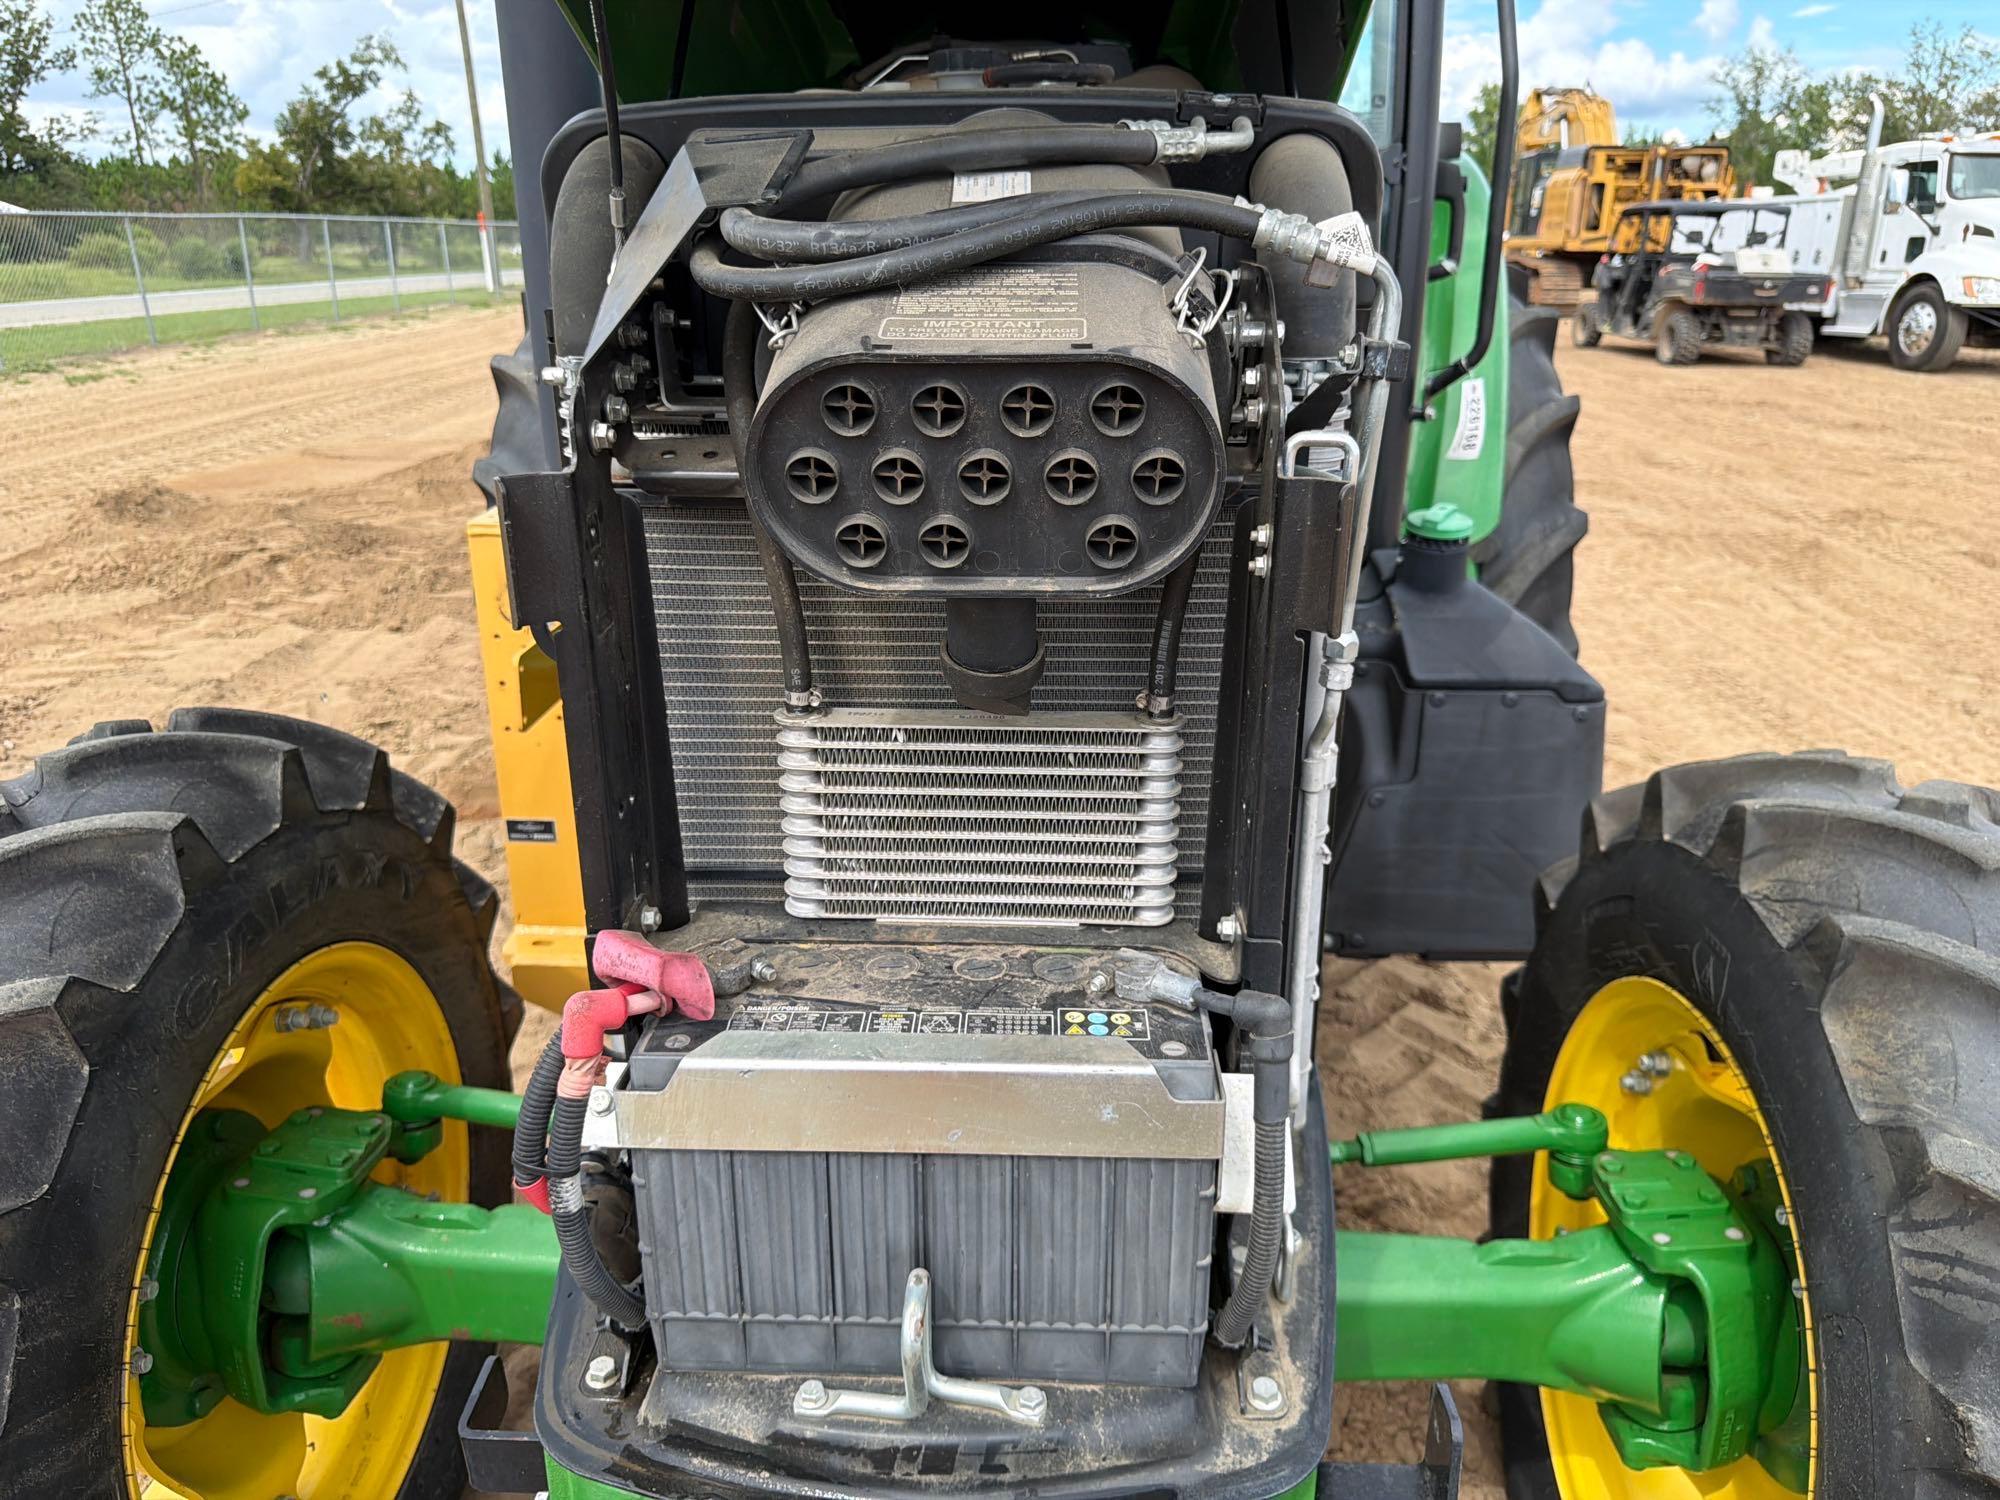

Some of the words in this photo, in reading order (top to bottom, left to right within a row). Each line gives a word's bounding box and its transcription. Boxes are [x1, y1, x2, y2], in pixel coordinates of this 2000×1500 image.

[923, 320, 1044, 328] IMPORTANT
[790, 668, 801, 686] SAE
[1155, 664, 1165, 685] 2019
